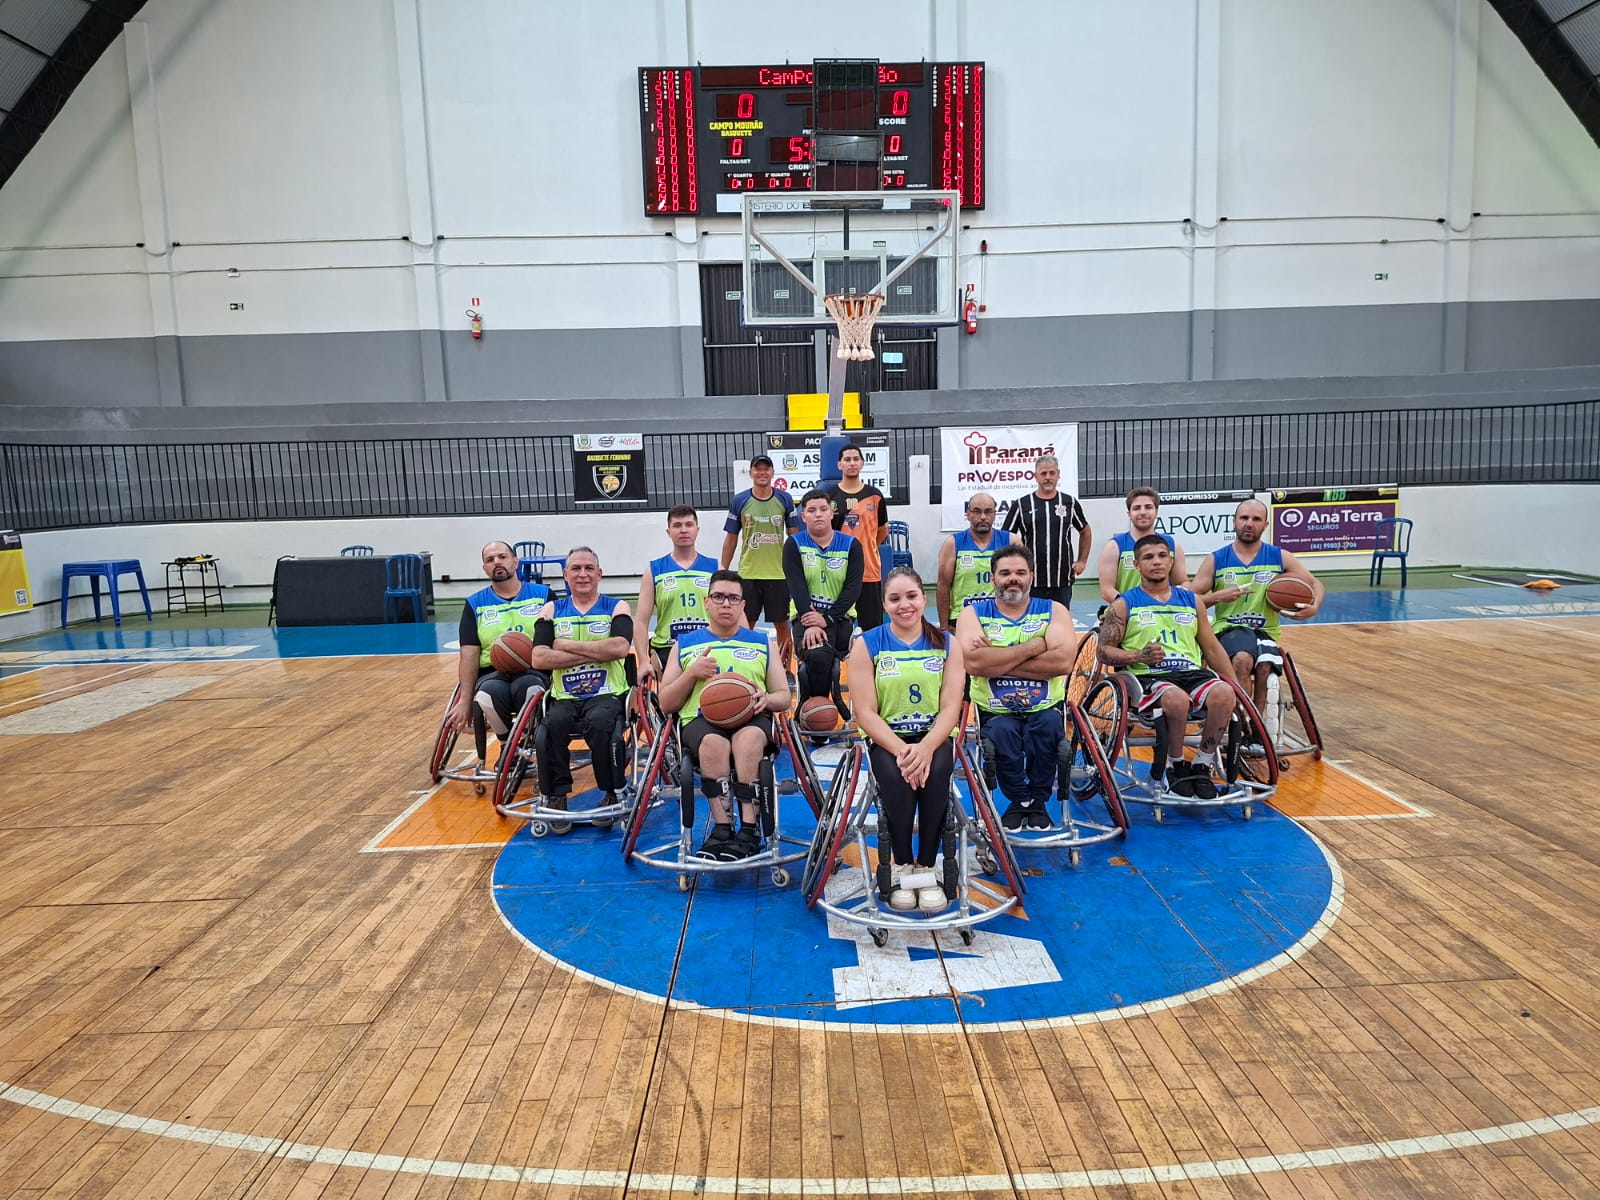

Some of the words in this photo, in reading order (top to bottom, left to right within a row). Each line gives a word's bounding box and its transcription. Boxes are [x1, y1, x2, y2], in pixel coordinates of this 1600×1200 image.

[738, 94, 754, 118] 0
[892, 90, 908, 116] 0
[709, 122, 734, 130] CAMPO
[734, 120, 764, 130] MOURÃO
[732, 138, 742, 156] 0
[890, 136, 901, 153] 0
[986, 443, 1054, 458] Paraná
[790, 480, 819, 490] ACA
[1308, 511, 1340, 524] Ana
[1341, 510, 1382, 522] Terra
[976, 572, 991, 584] 10
[680, 592, 696, 608] 15
[1160, 630, 1178, 644] 11
[566, 673, 602, 682] COIOTES
[909, 684, 922, 704] 8
